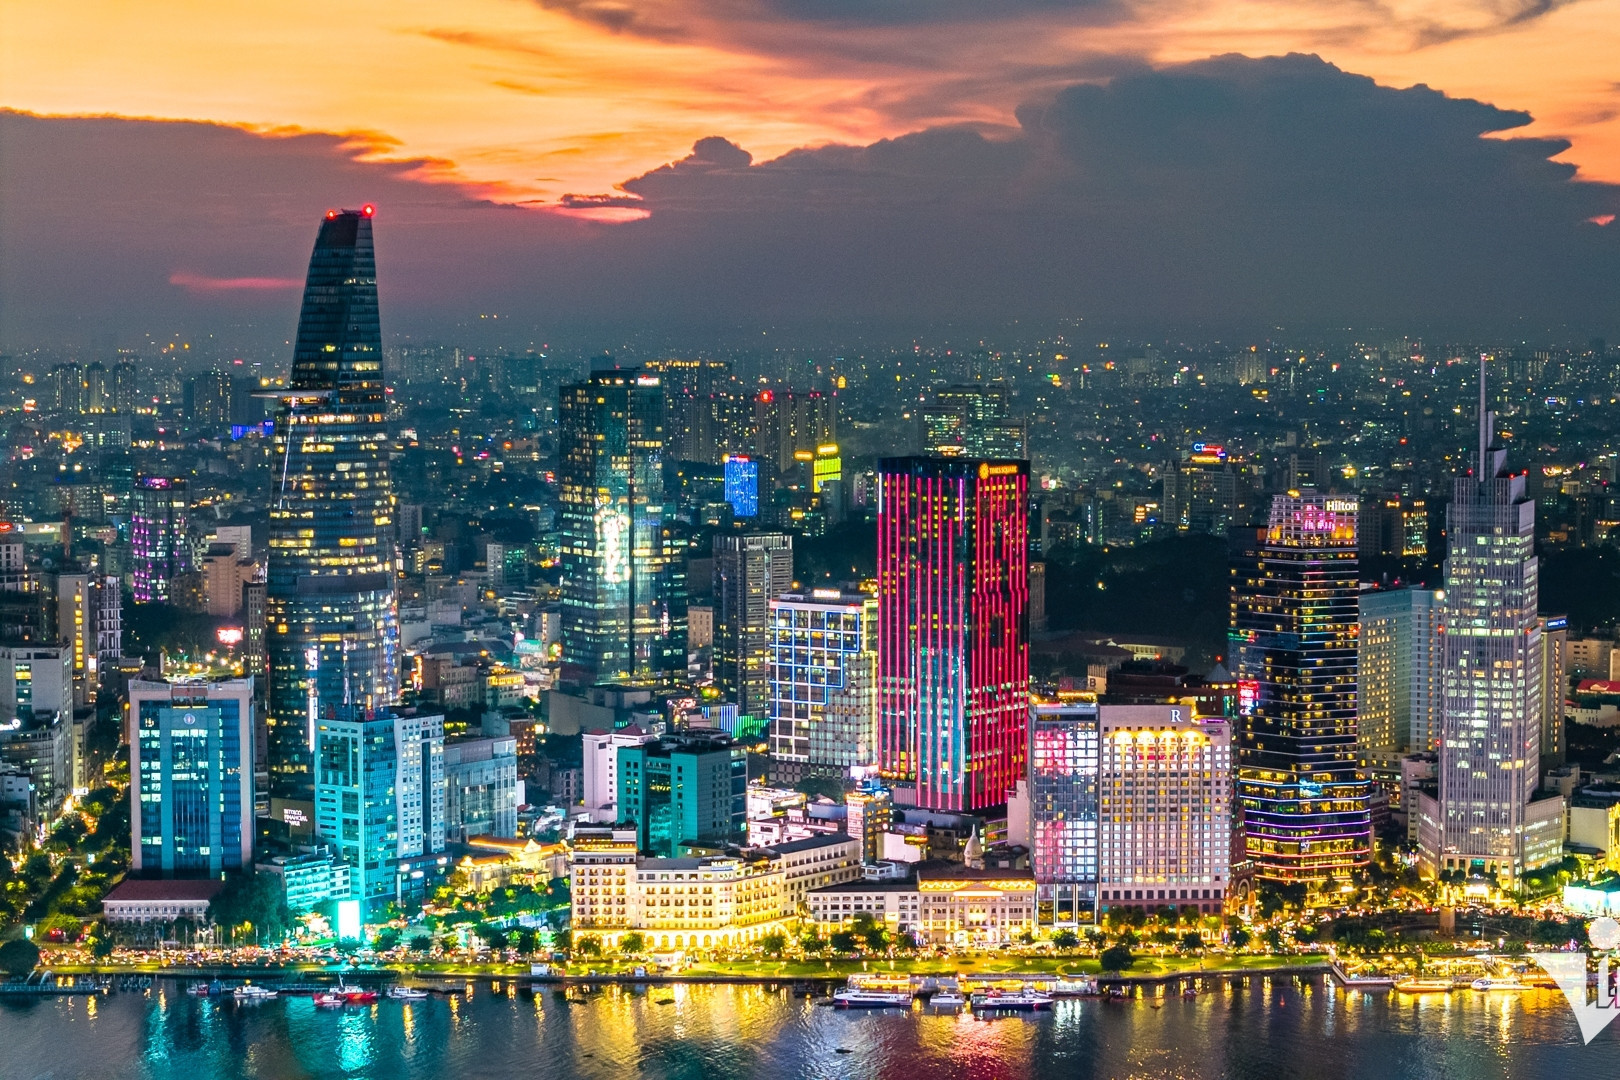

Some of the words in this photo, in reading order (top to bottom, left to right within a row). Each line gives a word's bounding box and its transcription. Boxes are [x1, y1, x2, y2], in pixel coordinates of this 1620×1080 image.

[1001, 465, 1018, 474] SQUARE
[1326, 500, 1358, 511] Hilton
[1171, 709, 1183, 722] R
